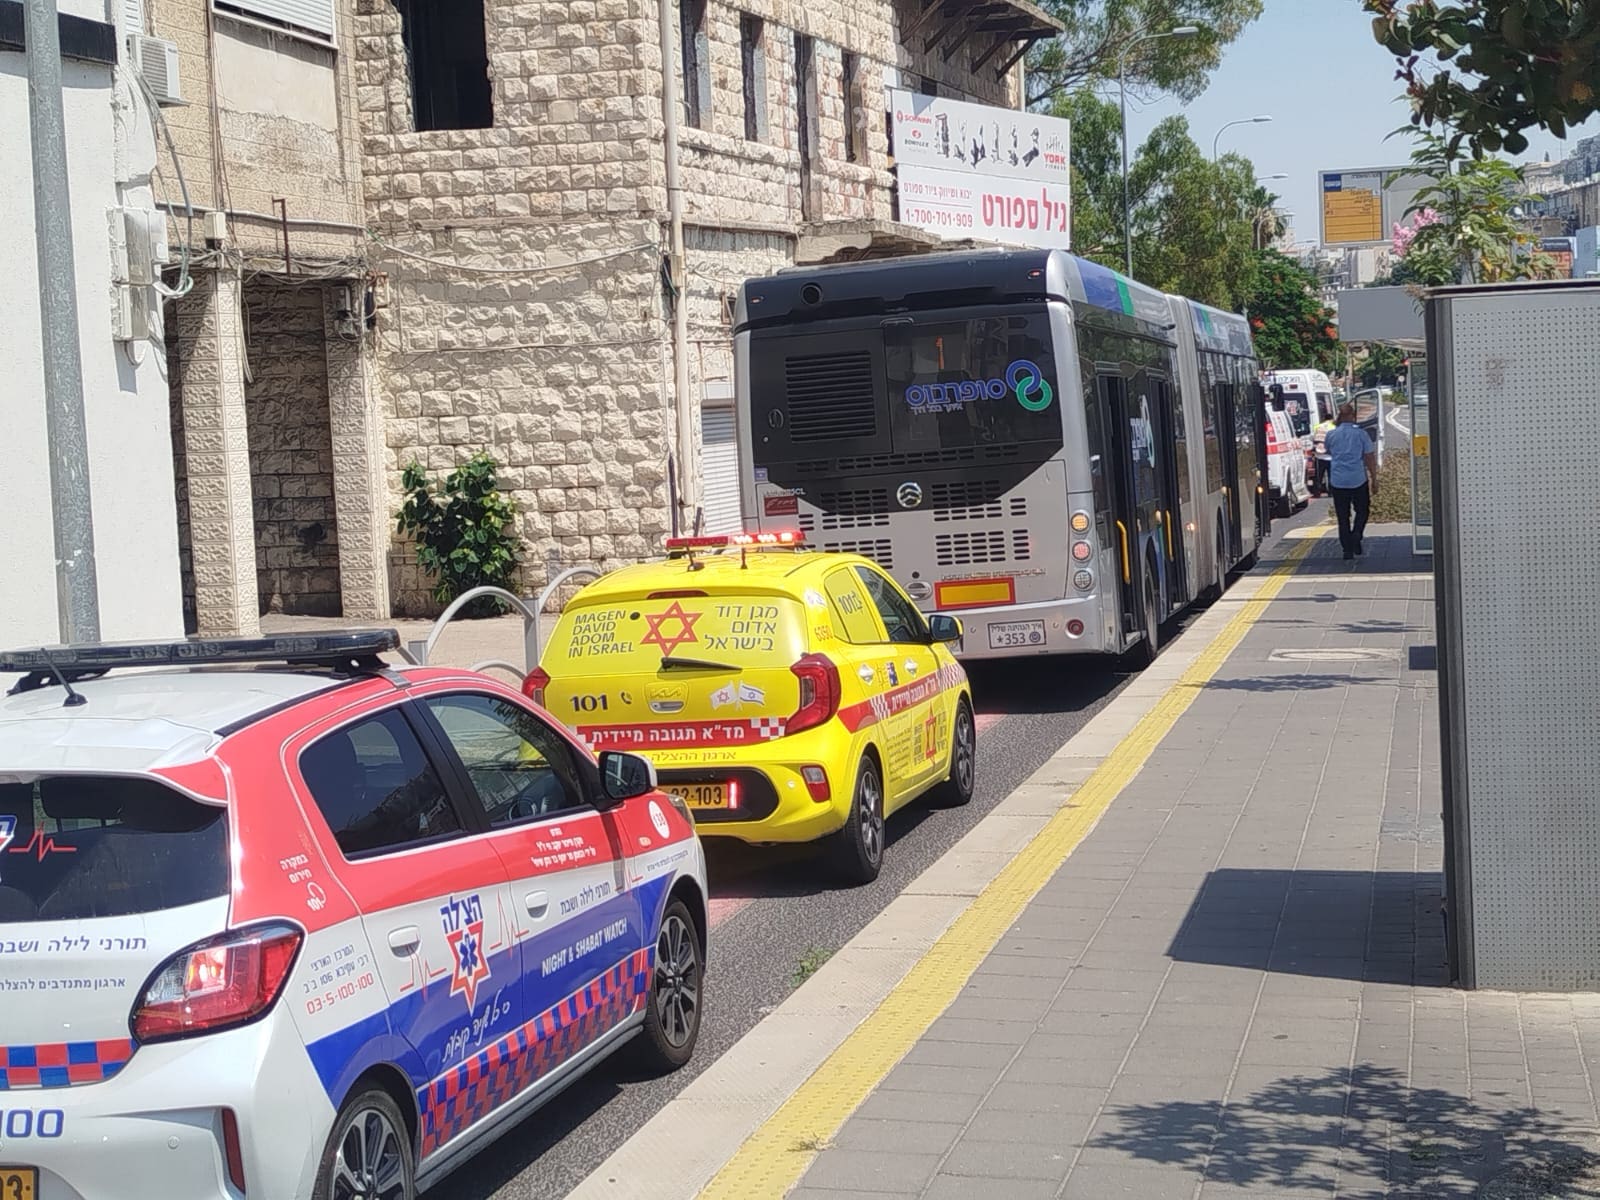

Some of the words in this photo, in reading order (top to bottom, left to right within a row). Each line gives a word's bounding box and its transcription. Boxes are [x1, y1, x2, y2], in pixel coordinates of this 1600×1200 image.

[1044, 153, 1066, 164] YORK
[904, 182, 923, 194] ספורט
[982, 194, 1038, 230] ספורט
[1042, 187, 1067, 232] גיל
[906, 208, 973, 228] 1-700-701-909
[905, 378, 1006, 407] סופרבוס
[575, 610, 626, 624] MAGEN
[715, 605, 746, 618] דוד
[749, 605, 779, 620] מגן
[572, 622, 617, 636] DAVID
[731, 620, 776, 634] אדום
[570, 632, 616, 647] ADOM
[704, 634, 774, 652] בישראל
[568, 647, 586, 658] IN
[587, 642, 635, 656] ISRAEL
[570, 694, 608, 712] 101
[591, 729, 644, 744] מיידית
[650, 726, 696, 742] תגובה
[702, 724, 744, 740] מד"א
[652, 751, 698, 761] ההצלה
[702, 750, 736, 760] ארגון
[580, 887, 594, 905] לילה
[440, 894, 483, 934] הצלה
[0, 940, 40, 954] ושב
[48, 936, 90, 952] לילה
[99, 936, 147, 950] תורני
[541, 950, 567, 977] NIGHT
[568, 947, 574, 963] &
[576, 934, 603, 960] SHABAT
[603, 918, 628, 944] WATCH
[38, 978, 92, 990] מתנדבים
[94, 978, 126, 990] ארגון
[320, 972, 334, 986] 106
[306, 972, 374, 1015] 03-5-100-100
